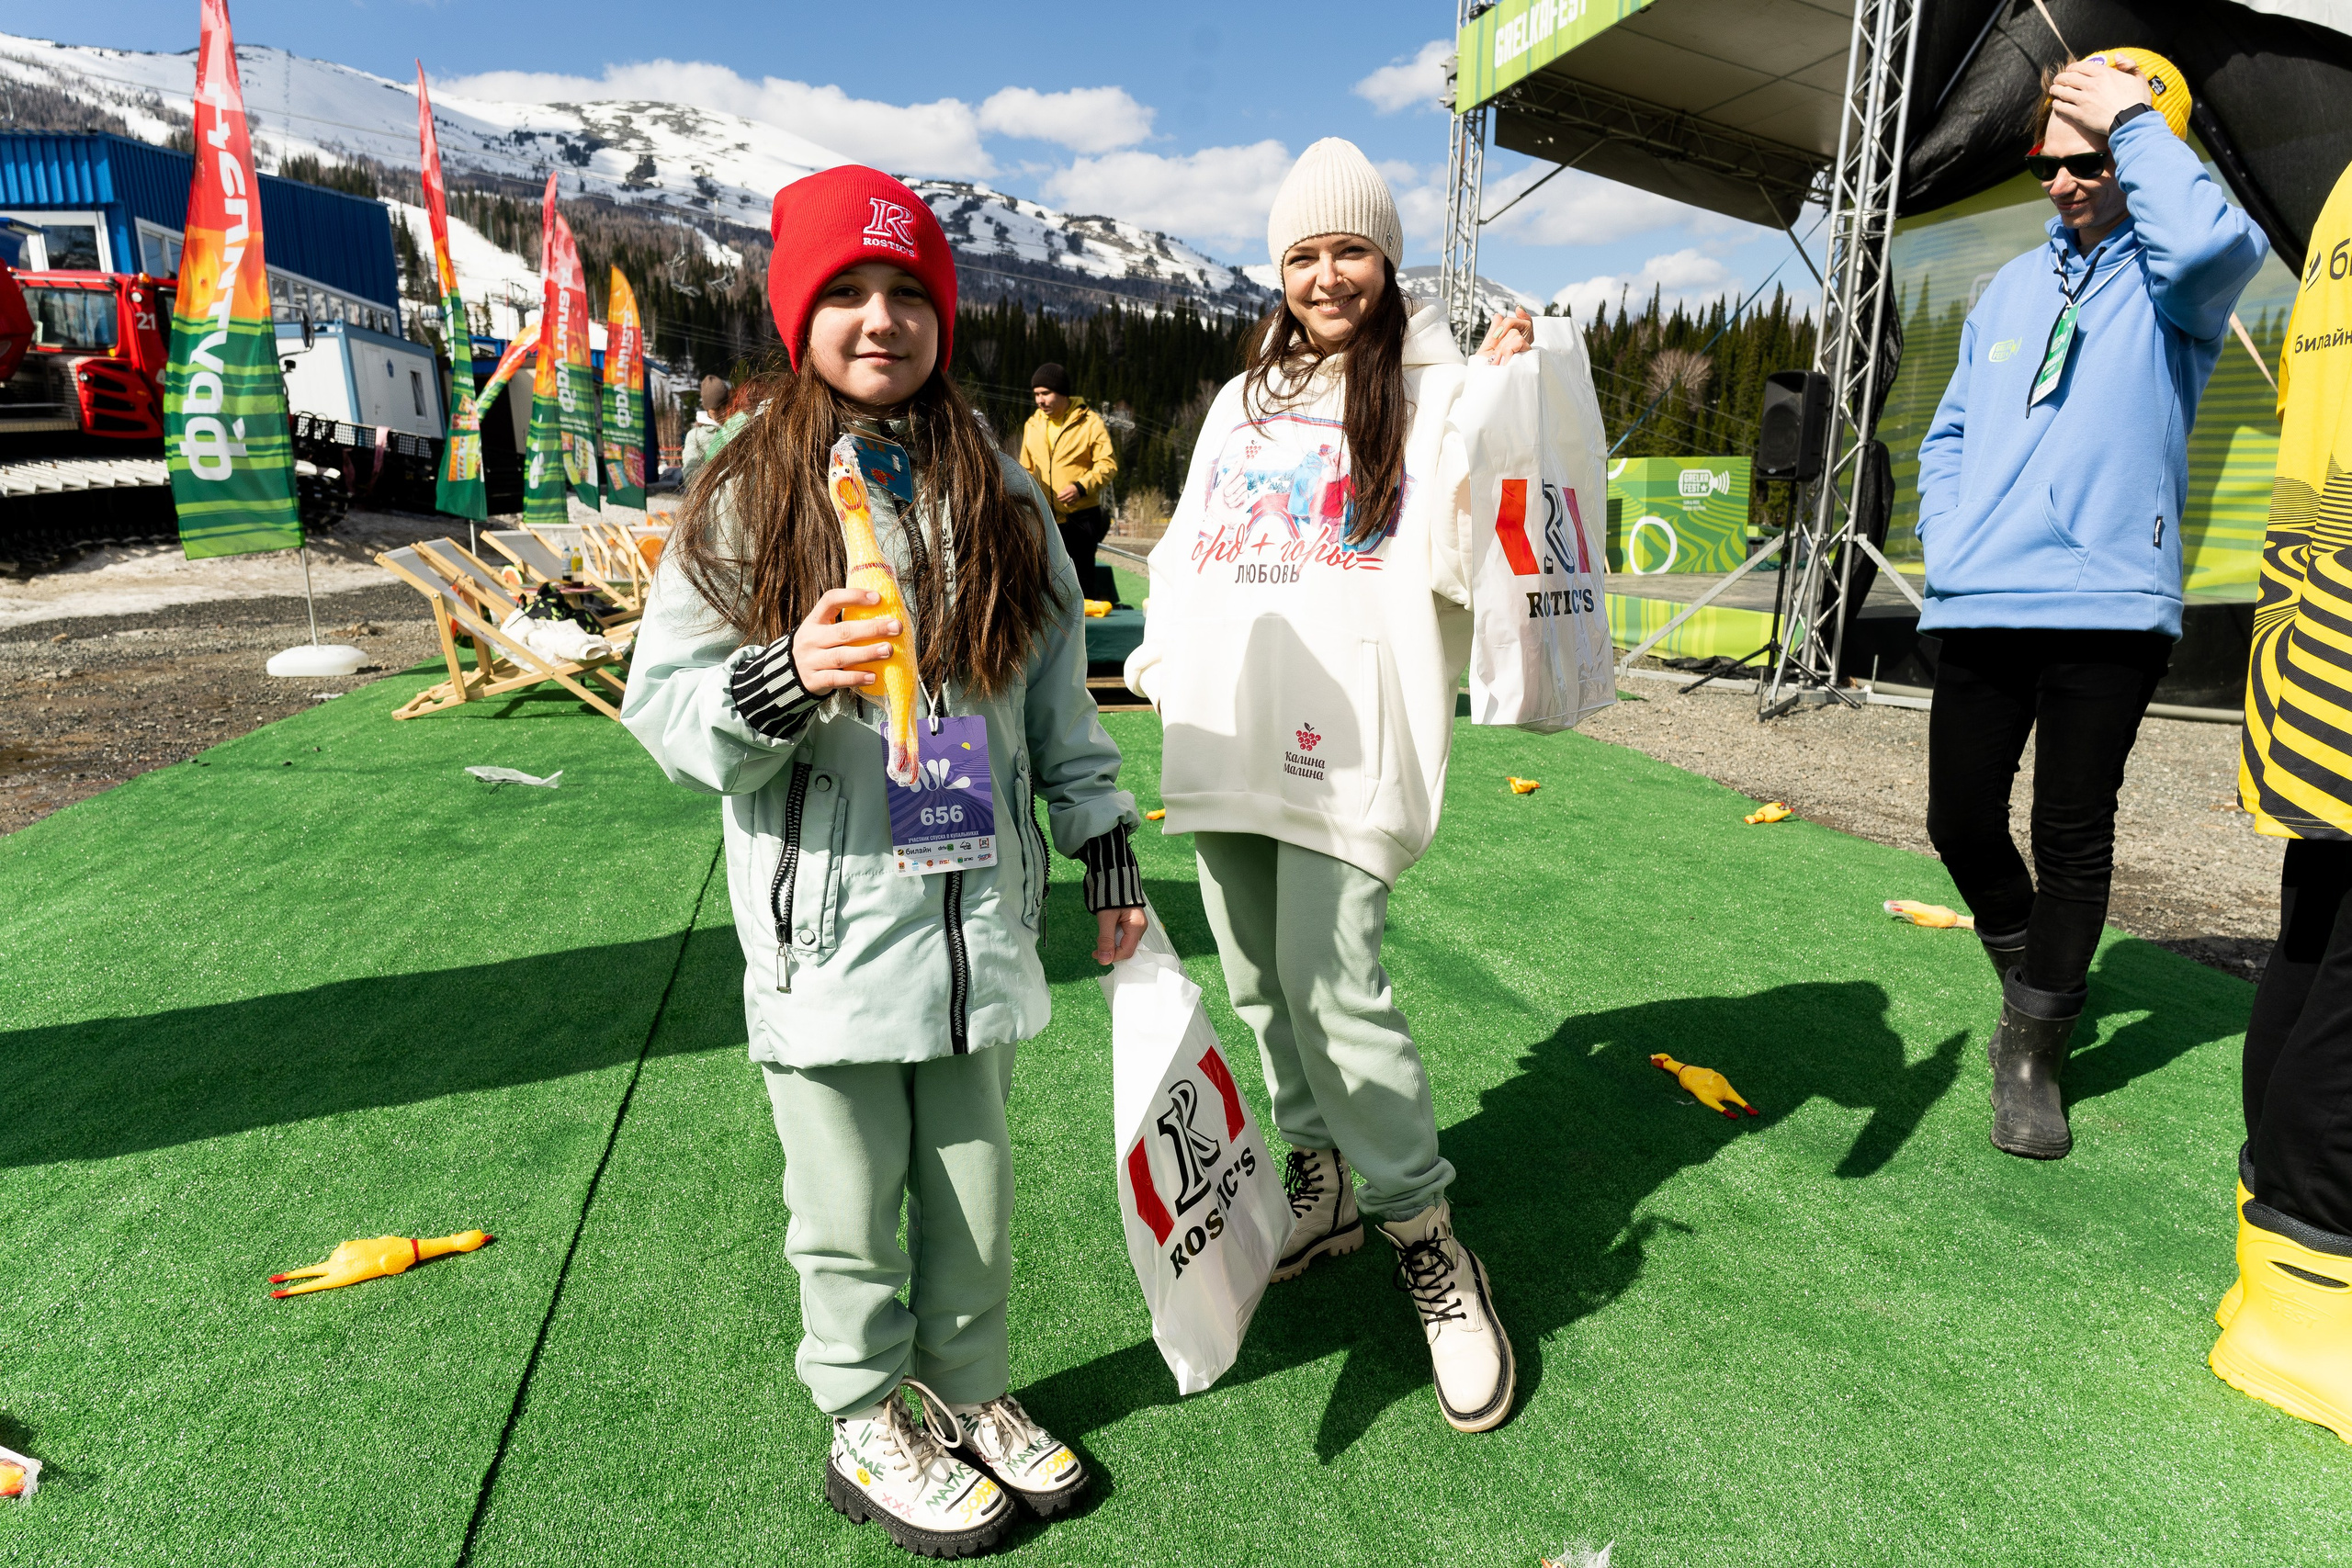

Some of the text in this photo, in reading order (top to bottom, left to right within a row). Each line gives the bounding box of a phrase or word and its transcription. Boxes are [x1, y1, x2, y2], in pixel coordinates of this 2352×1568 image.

[863, 197, 915, 246] R
[862, 237, 916, 257] ROSTIC'S
[135, 312, 156, 331] 21
[1683, 472, 1709, 482] GRELKA
[1683, 483, 1700, 493] FEST
[1234, 563, 1301, 584] ЛЮБОВЬ
[920, 804, 965, 827] 656
[905, 845, 932, 855] билайн
[2269, 1296, 2319, 1329] BEST
